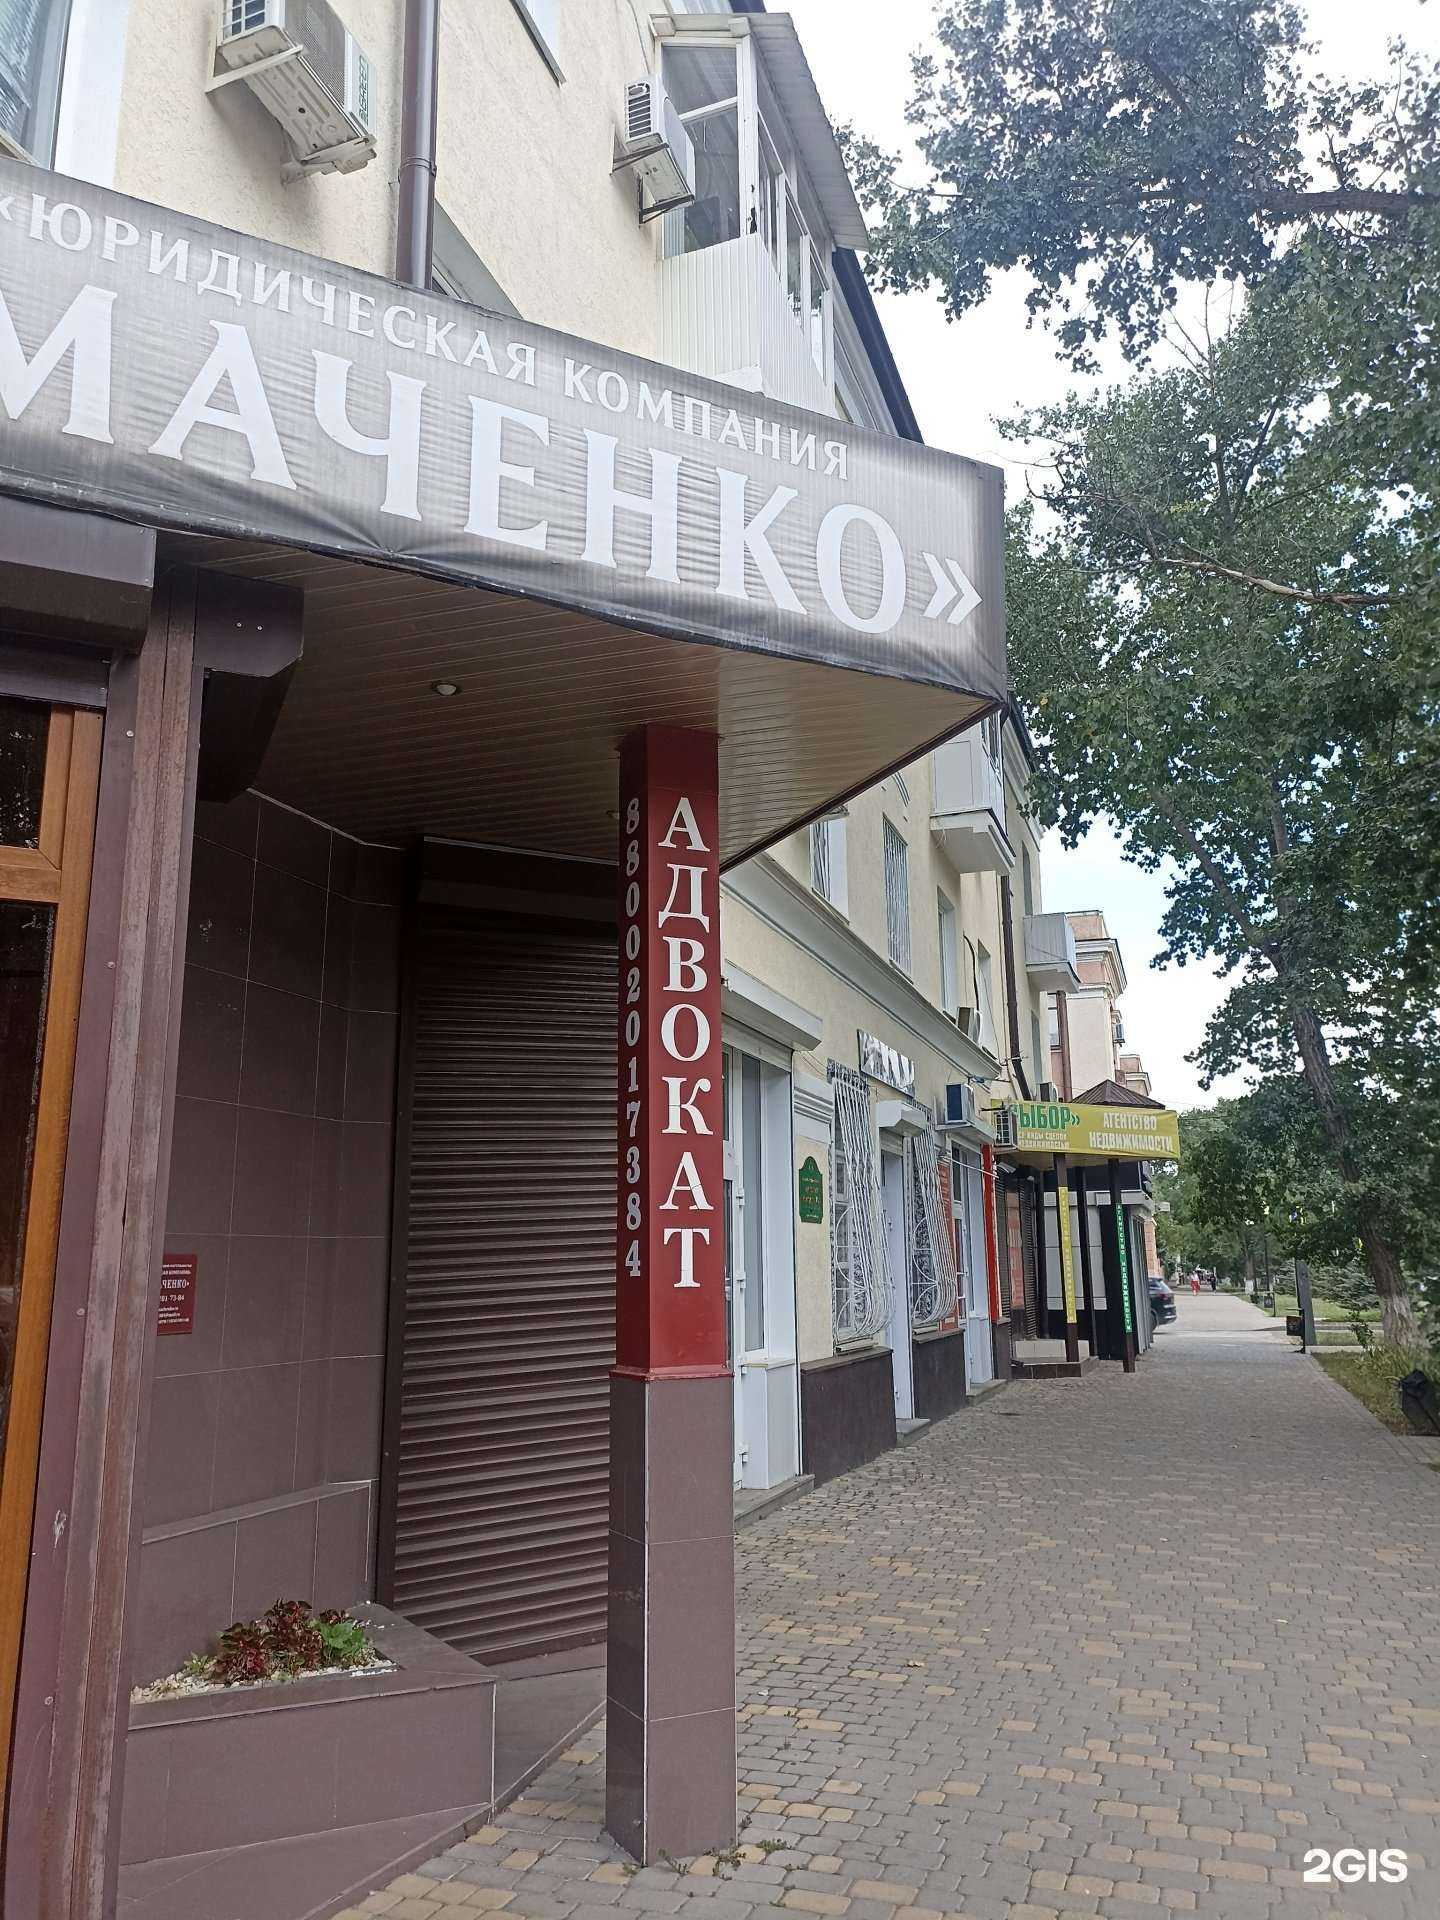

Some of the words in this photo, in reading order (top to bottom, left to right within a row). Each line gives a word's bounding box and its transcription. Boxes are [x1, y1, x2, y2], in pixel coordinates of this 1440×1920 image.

[563, 357, 848, 480] КОМПАНИЯ
[657, 796, 714, 1289] АДВОКАТ
[1014, 1103, 1080, 1130] ЫБОР»
[1103, 1112, 1157, 1130] АГЕНТСТВО
[1089, 1131, 1174, 1152] НЕДВИЖИМОСТИ
